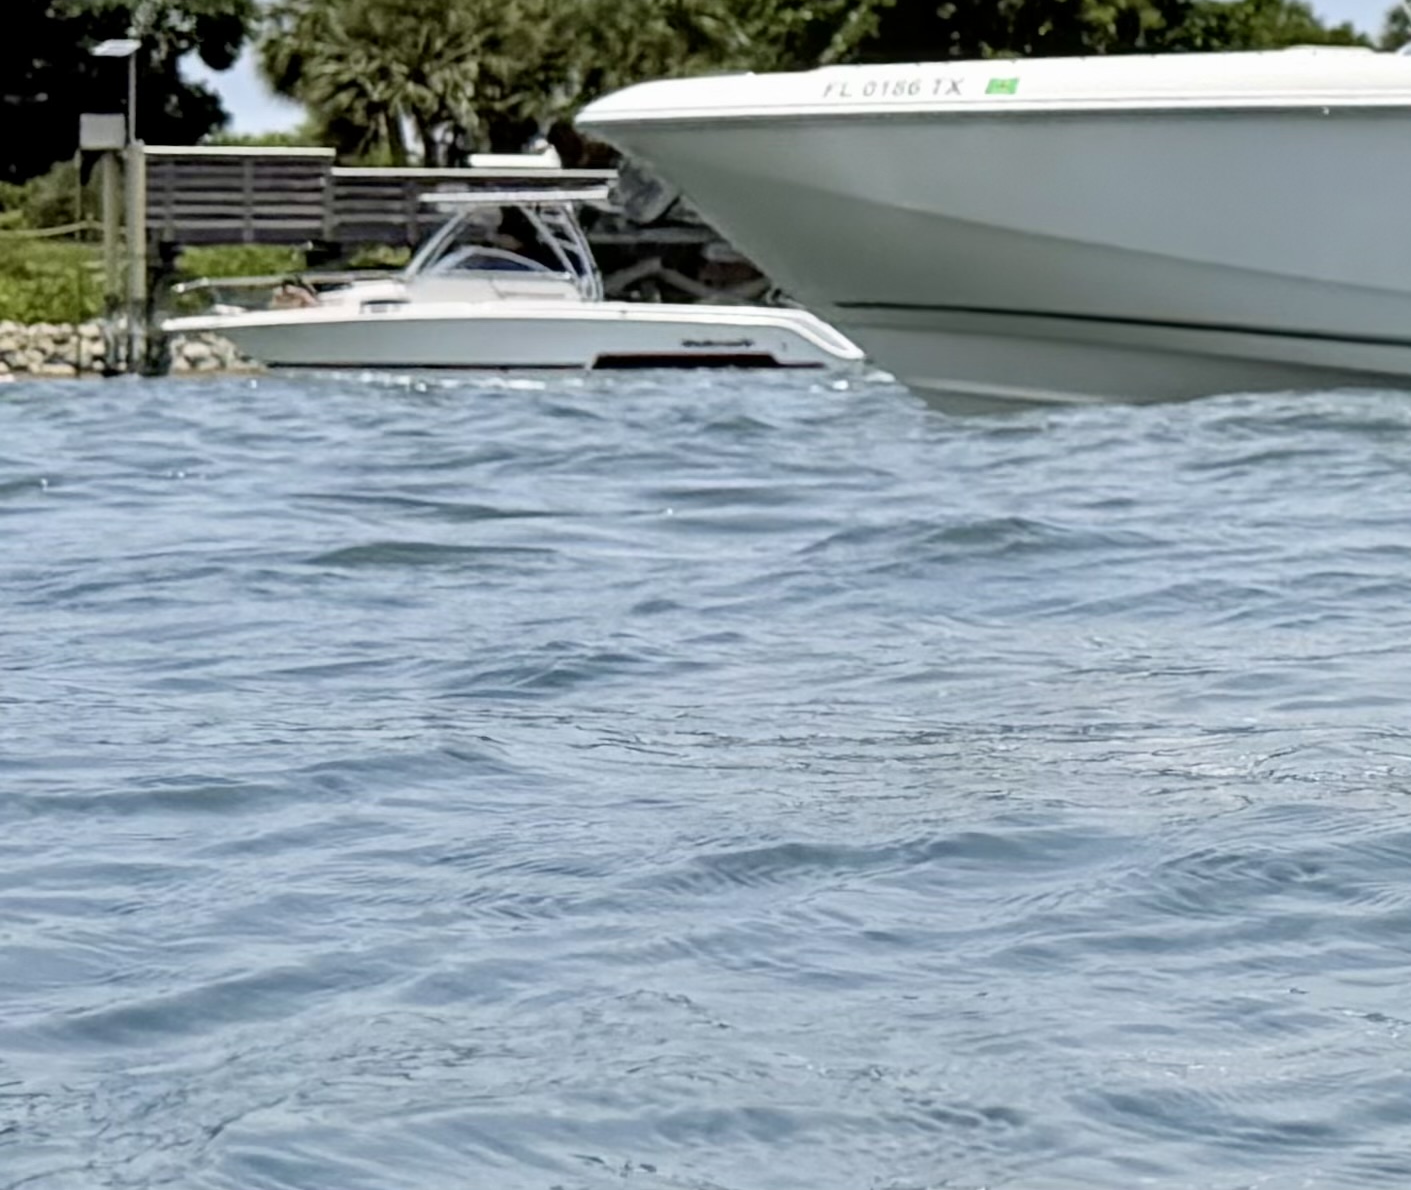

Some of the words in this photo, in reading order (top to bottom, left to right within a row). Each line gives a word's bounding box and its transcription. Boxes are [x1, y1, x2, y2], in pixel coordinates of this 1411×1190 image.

[823, 81, 852, 98] FL
[862, 78, 922, 98] 0186
[931, 76, 965, 97] TX
